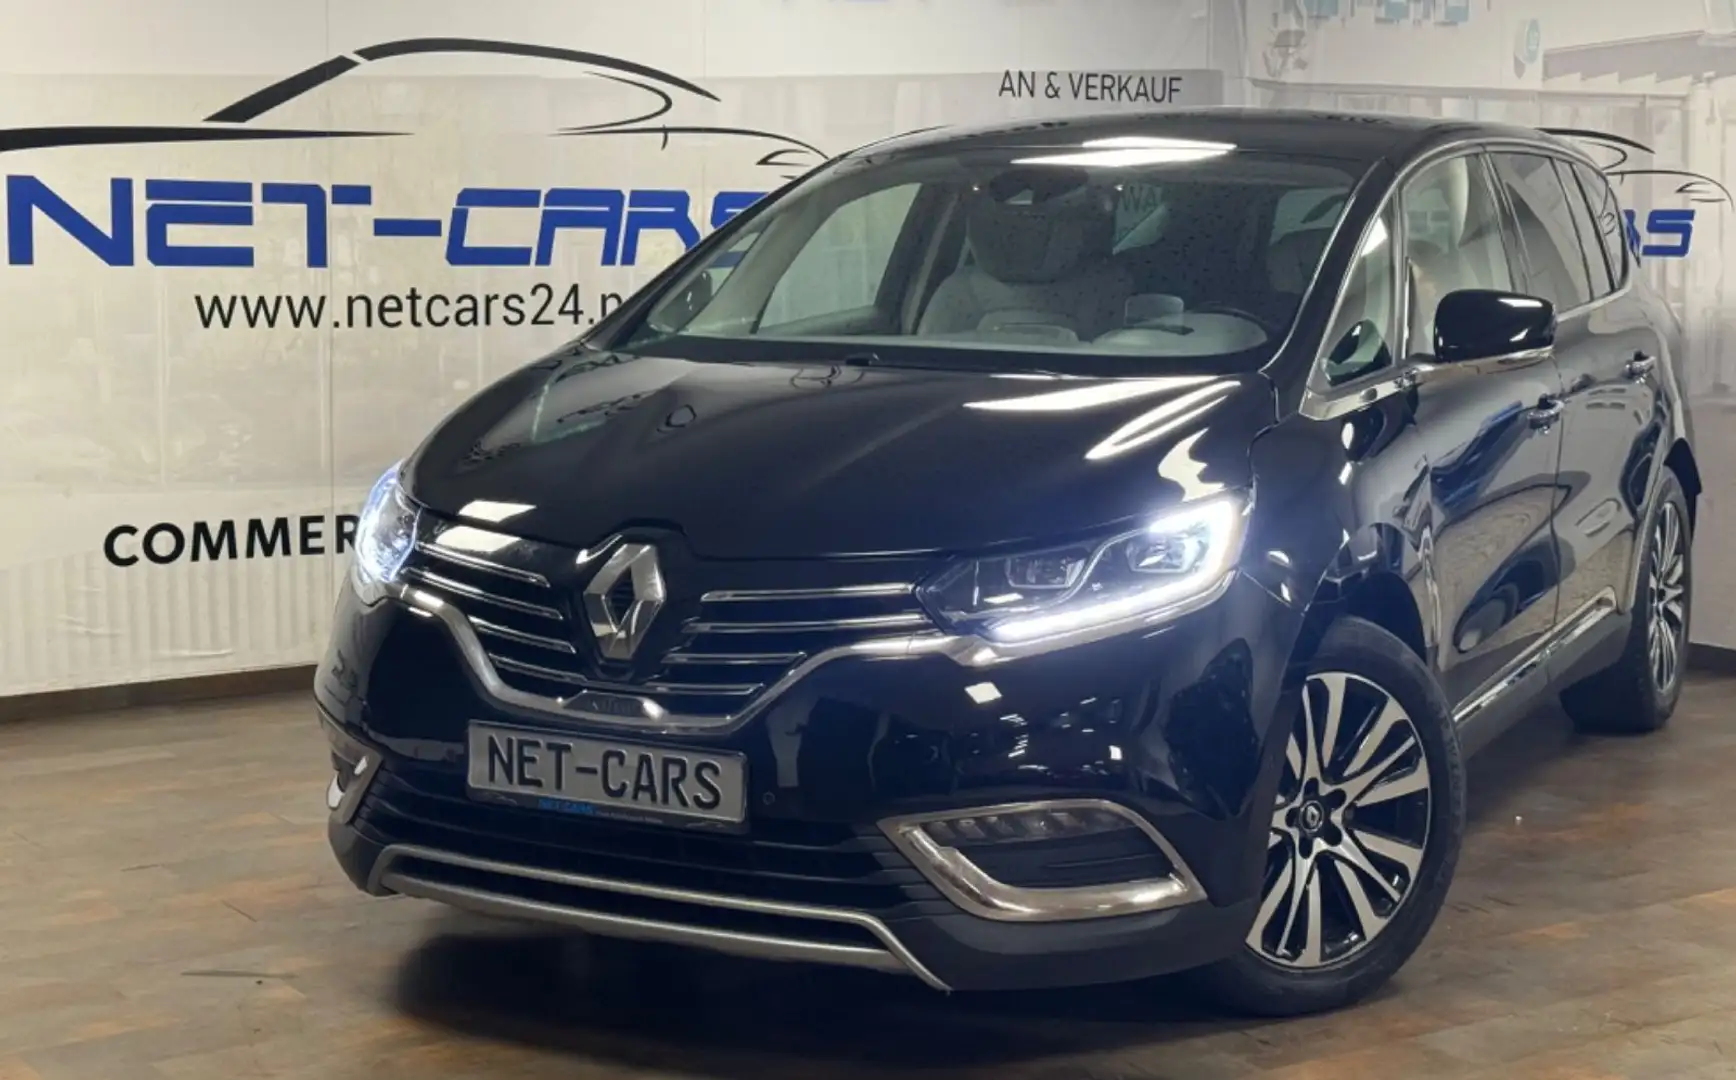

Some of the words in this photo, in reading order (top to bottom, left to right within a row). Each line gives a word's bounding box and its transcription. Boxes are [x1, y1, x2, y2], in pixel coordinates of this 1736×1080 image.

[998, 69, 1036, 98] AN
[1044, 71, 1061, 99] &
[1068, 72, 1182, 103] VERKAUF
[103, 515, 360, 567] COMMER
[488, 734, 722, 811] NET-CARS
